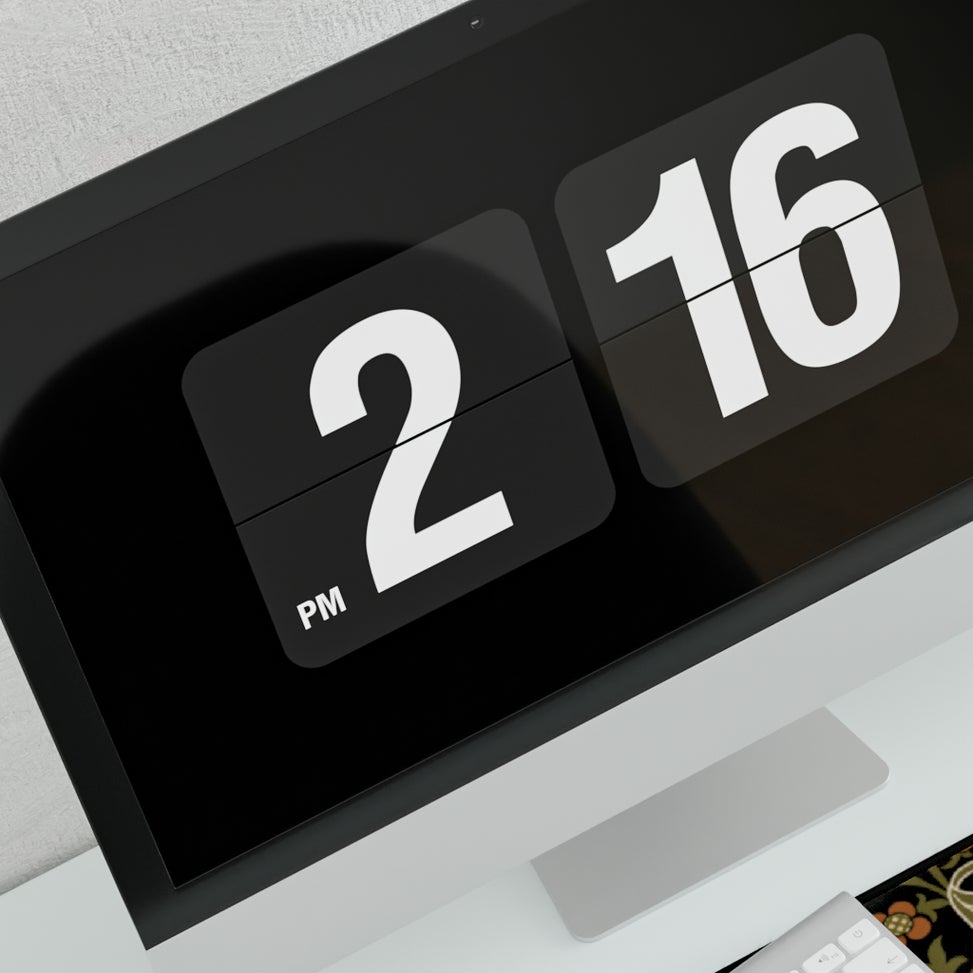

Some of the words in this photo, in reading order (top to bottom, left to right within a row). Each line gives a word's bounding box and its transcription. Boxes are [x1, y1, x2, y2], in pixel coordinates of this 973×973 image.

[309, 309, 514, 594] 2
[605, 102, 901, 418] 16
[296, 585, 347, 631] PM
